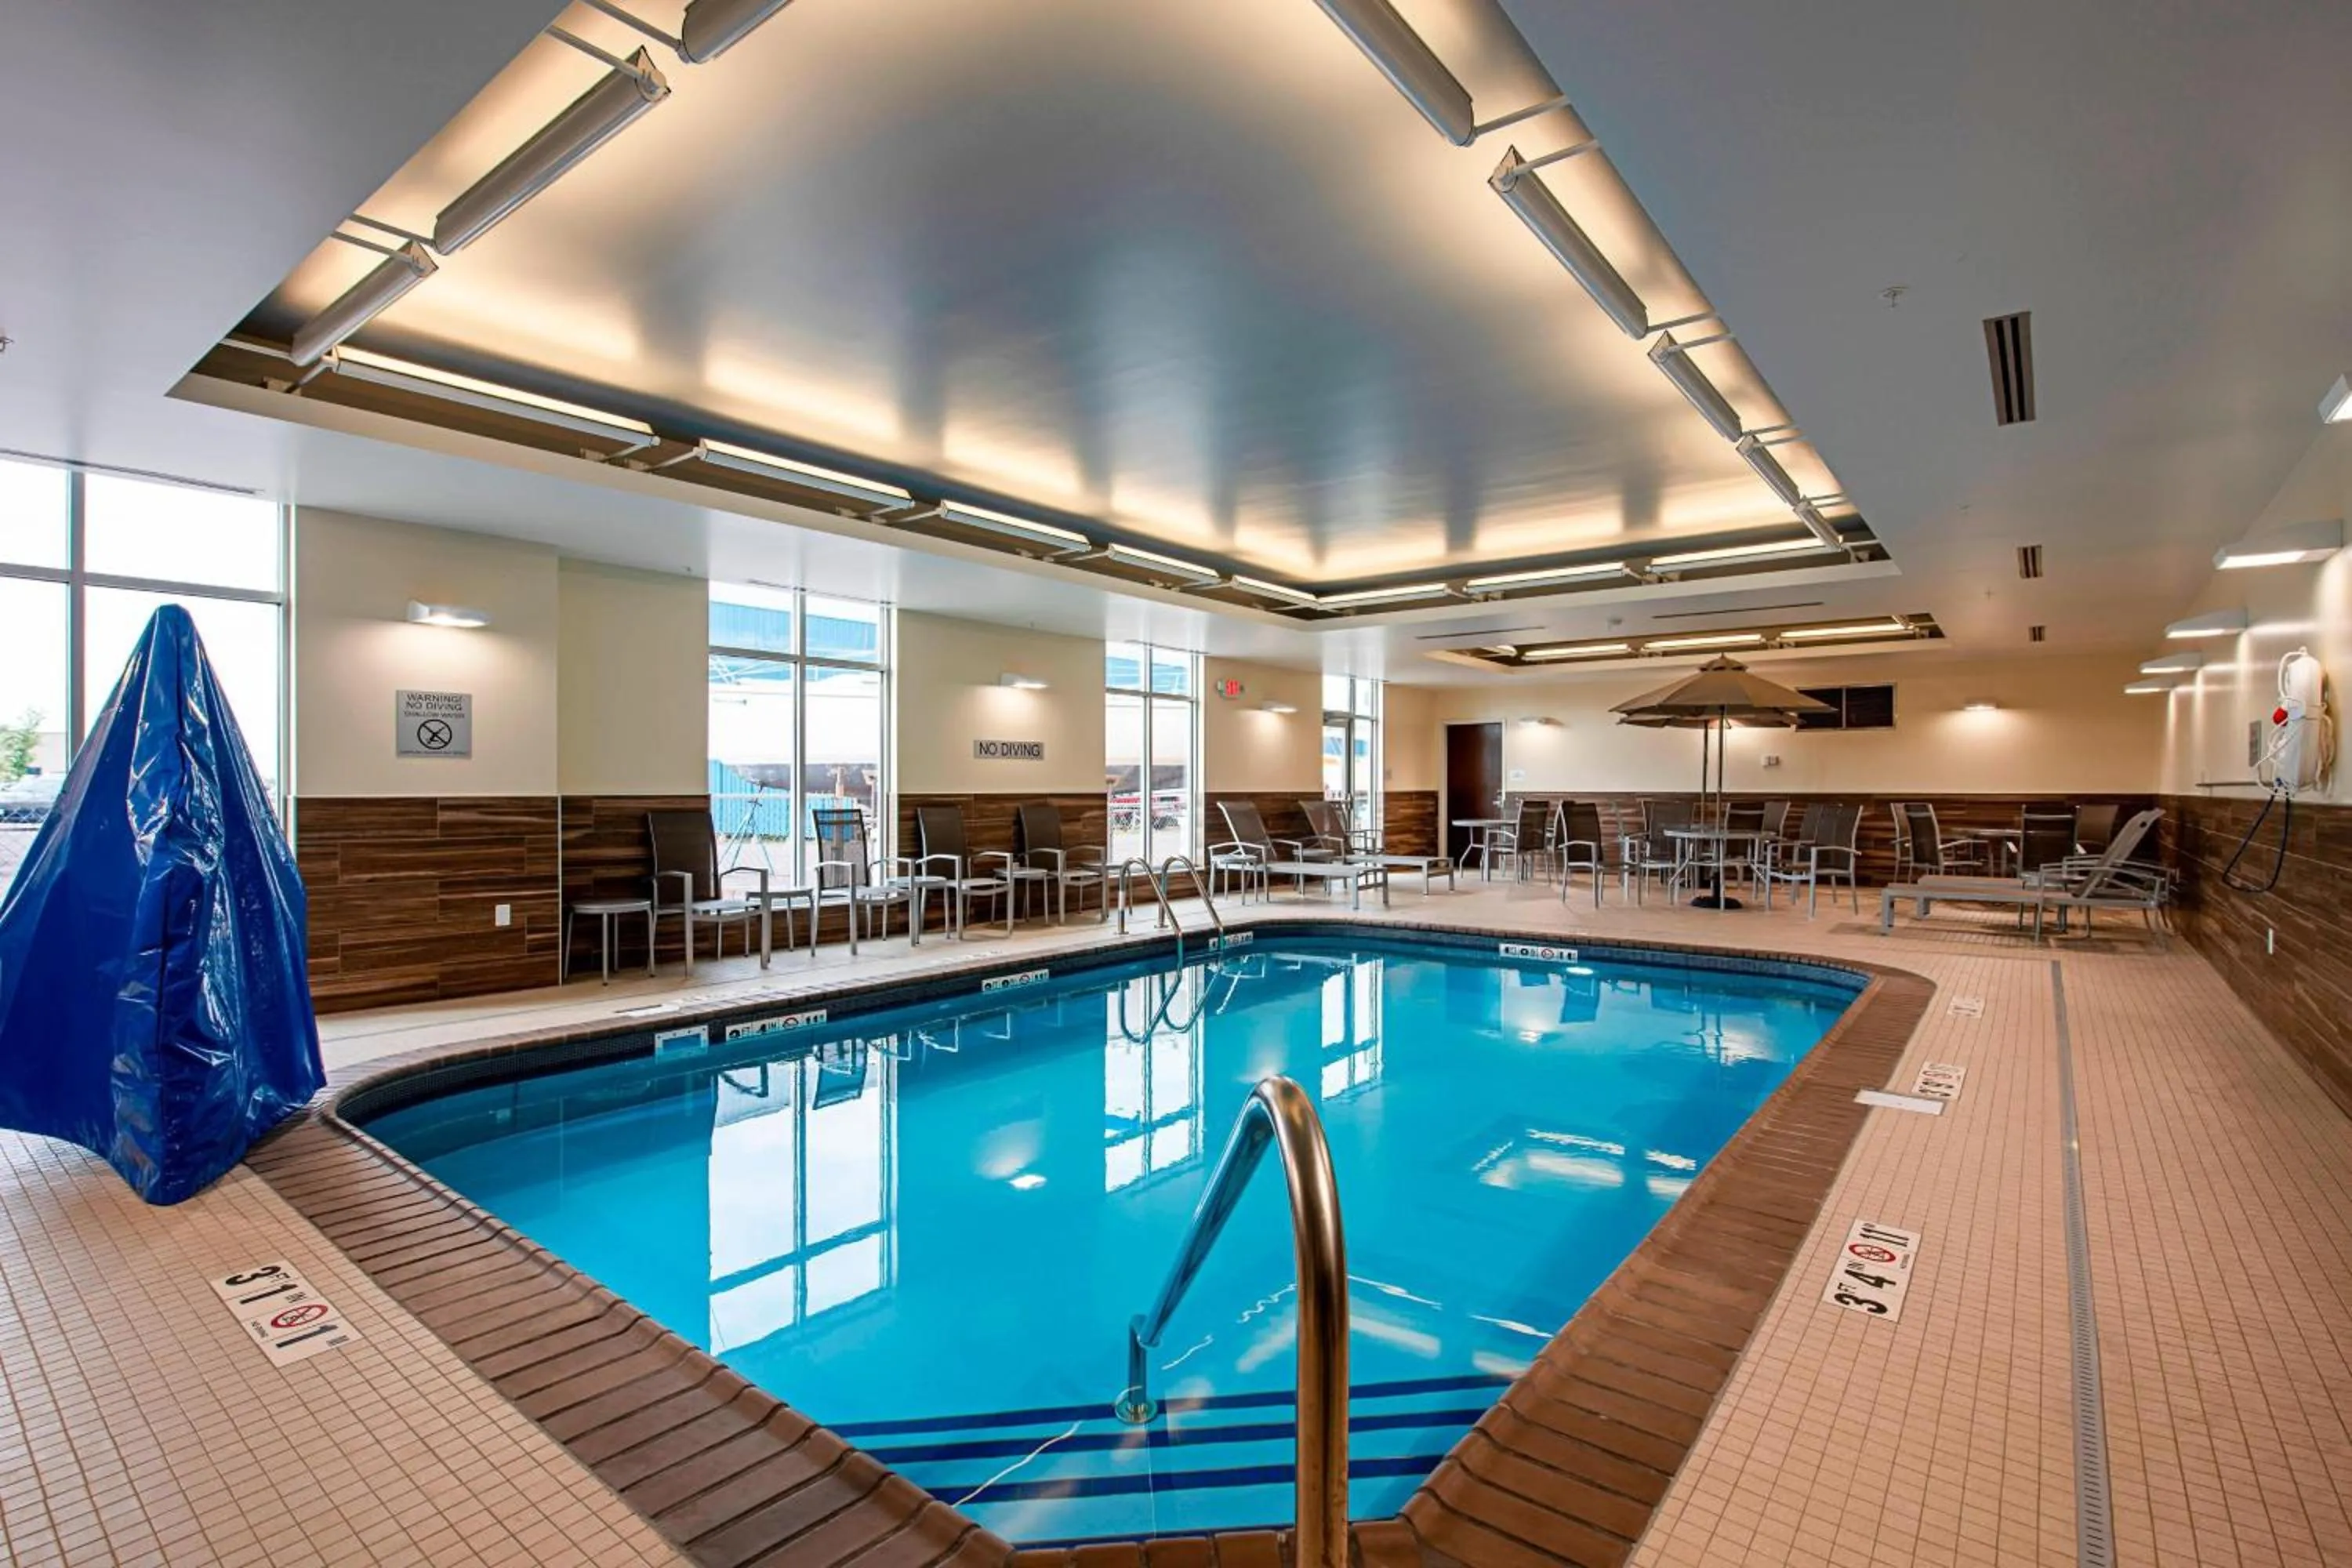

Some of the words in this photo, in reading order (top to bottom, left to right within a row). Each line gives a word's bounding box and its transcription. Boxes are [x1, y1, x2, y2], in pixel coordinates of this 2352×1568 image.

[426, 702, 462, 711] DIVING
[978, 742, 998, 755] NO
[1000, 742, 1040, 757] DIVING
